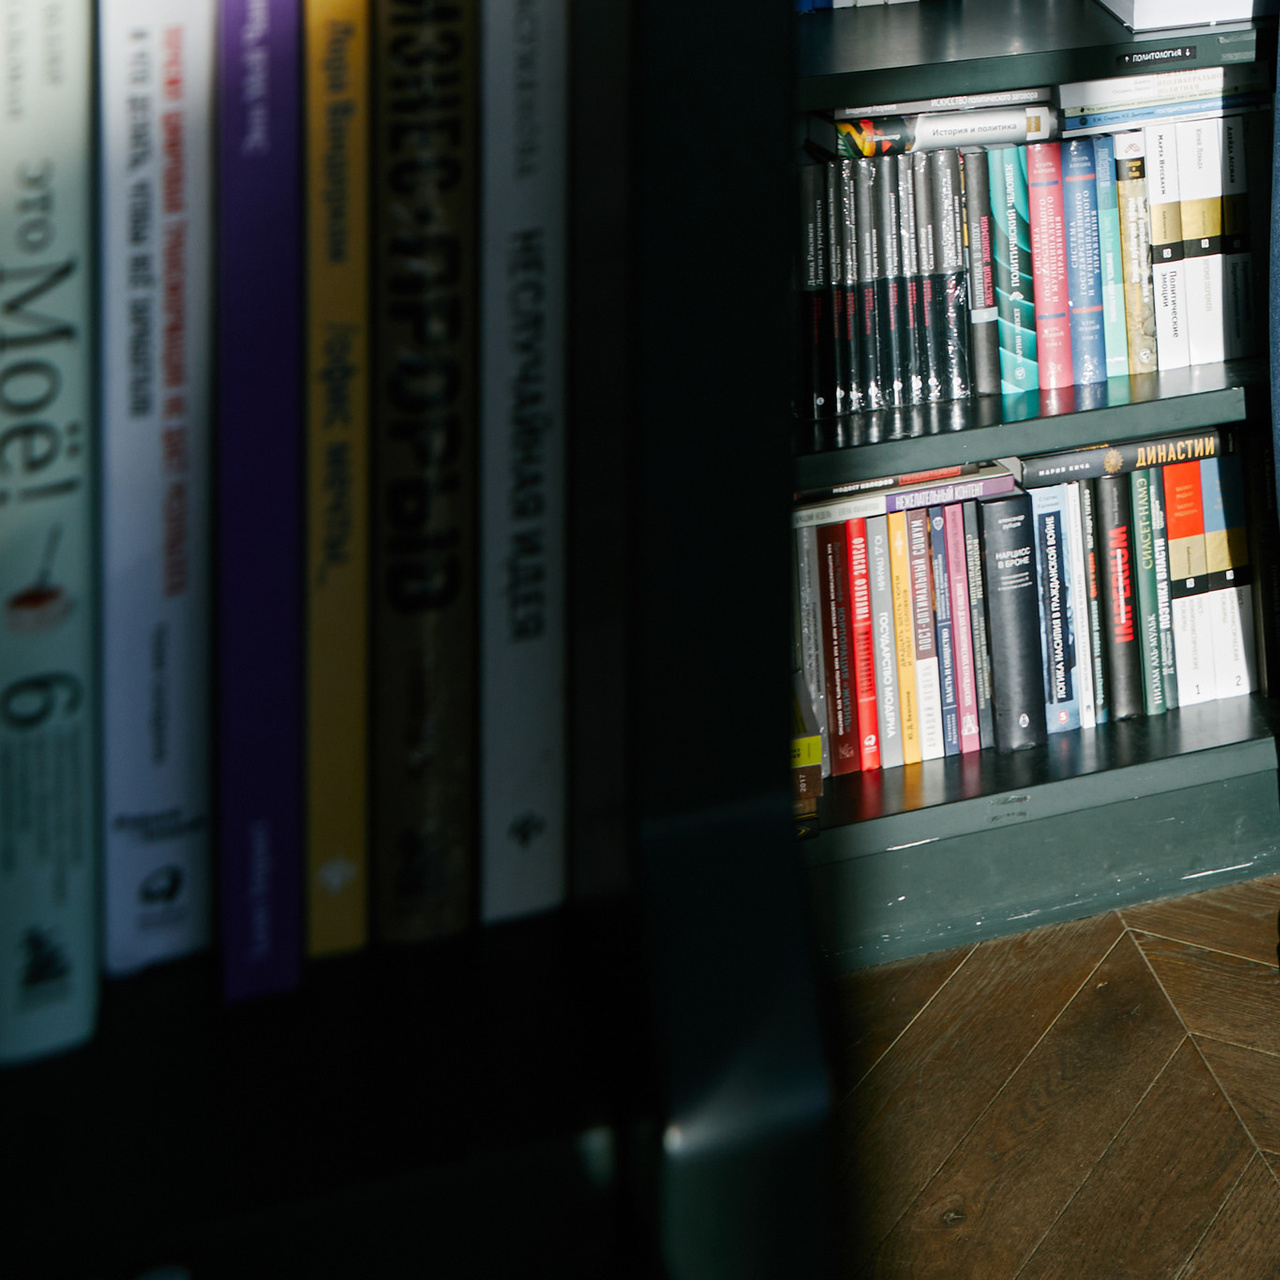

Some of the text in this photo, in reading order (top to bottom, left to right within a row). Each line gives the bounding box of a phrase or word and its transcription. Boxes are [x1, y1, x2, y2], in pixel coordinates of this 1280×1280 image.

[931, 95, 968, 108] ИСКУССТВО
[932, 122, 1017, 138] История политика
[980, 215, 992, 266] ЭКОНОМИИ
[1005, 163, 1020, 288] ПОЛИТИЧЕСКИЙ ЧЕЛОВЕК
[1169, 270, 1180, 339] Политические
[507, 228, 549, 520] НЕСЛУЧАЙНАЯ
[895, 481, 985, 511] НЕЖЕЛАТЕЛЬНЫЙ КОНТЕНТ
[1038, 436, 1216, 478] МАРИЯ ДИНАСТИИ
[995, 547, 1031, 560] НАРЦИСС
[1005, 556, 1031, 568] БРОНЕ
[1136, 476, 1154, 570] СИАСЕТ-НАМЭ
[507, 528, 547, 643] ИДЕЯ
[910, 519, 932, 652] ПОСТ-ОПТИМАЛЬНЫЙ СОЦИУМ
[1047, 547, 1067, 700] ЛОГИКА НАСИЛИЯ ГРАЖДАНСКОЙ
[1108, 525, 1134, 644] IMPERIUM
[1154, 537, 1172, 629] ПОЭТИКА ВЛАСТИ
[878, 611, 897, 739] ГОСУДАРСТВО МОДЕРНА
